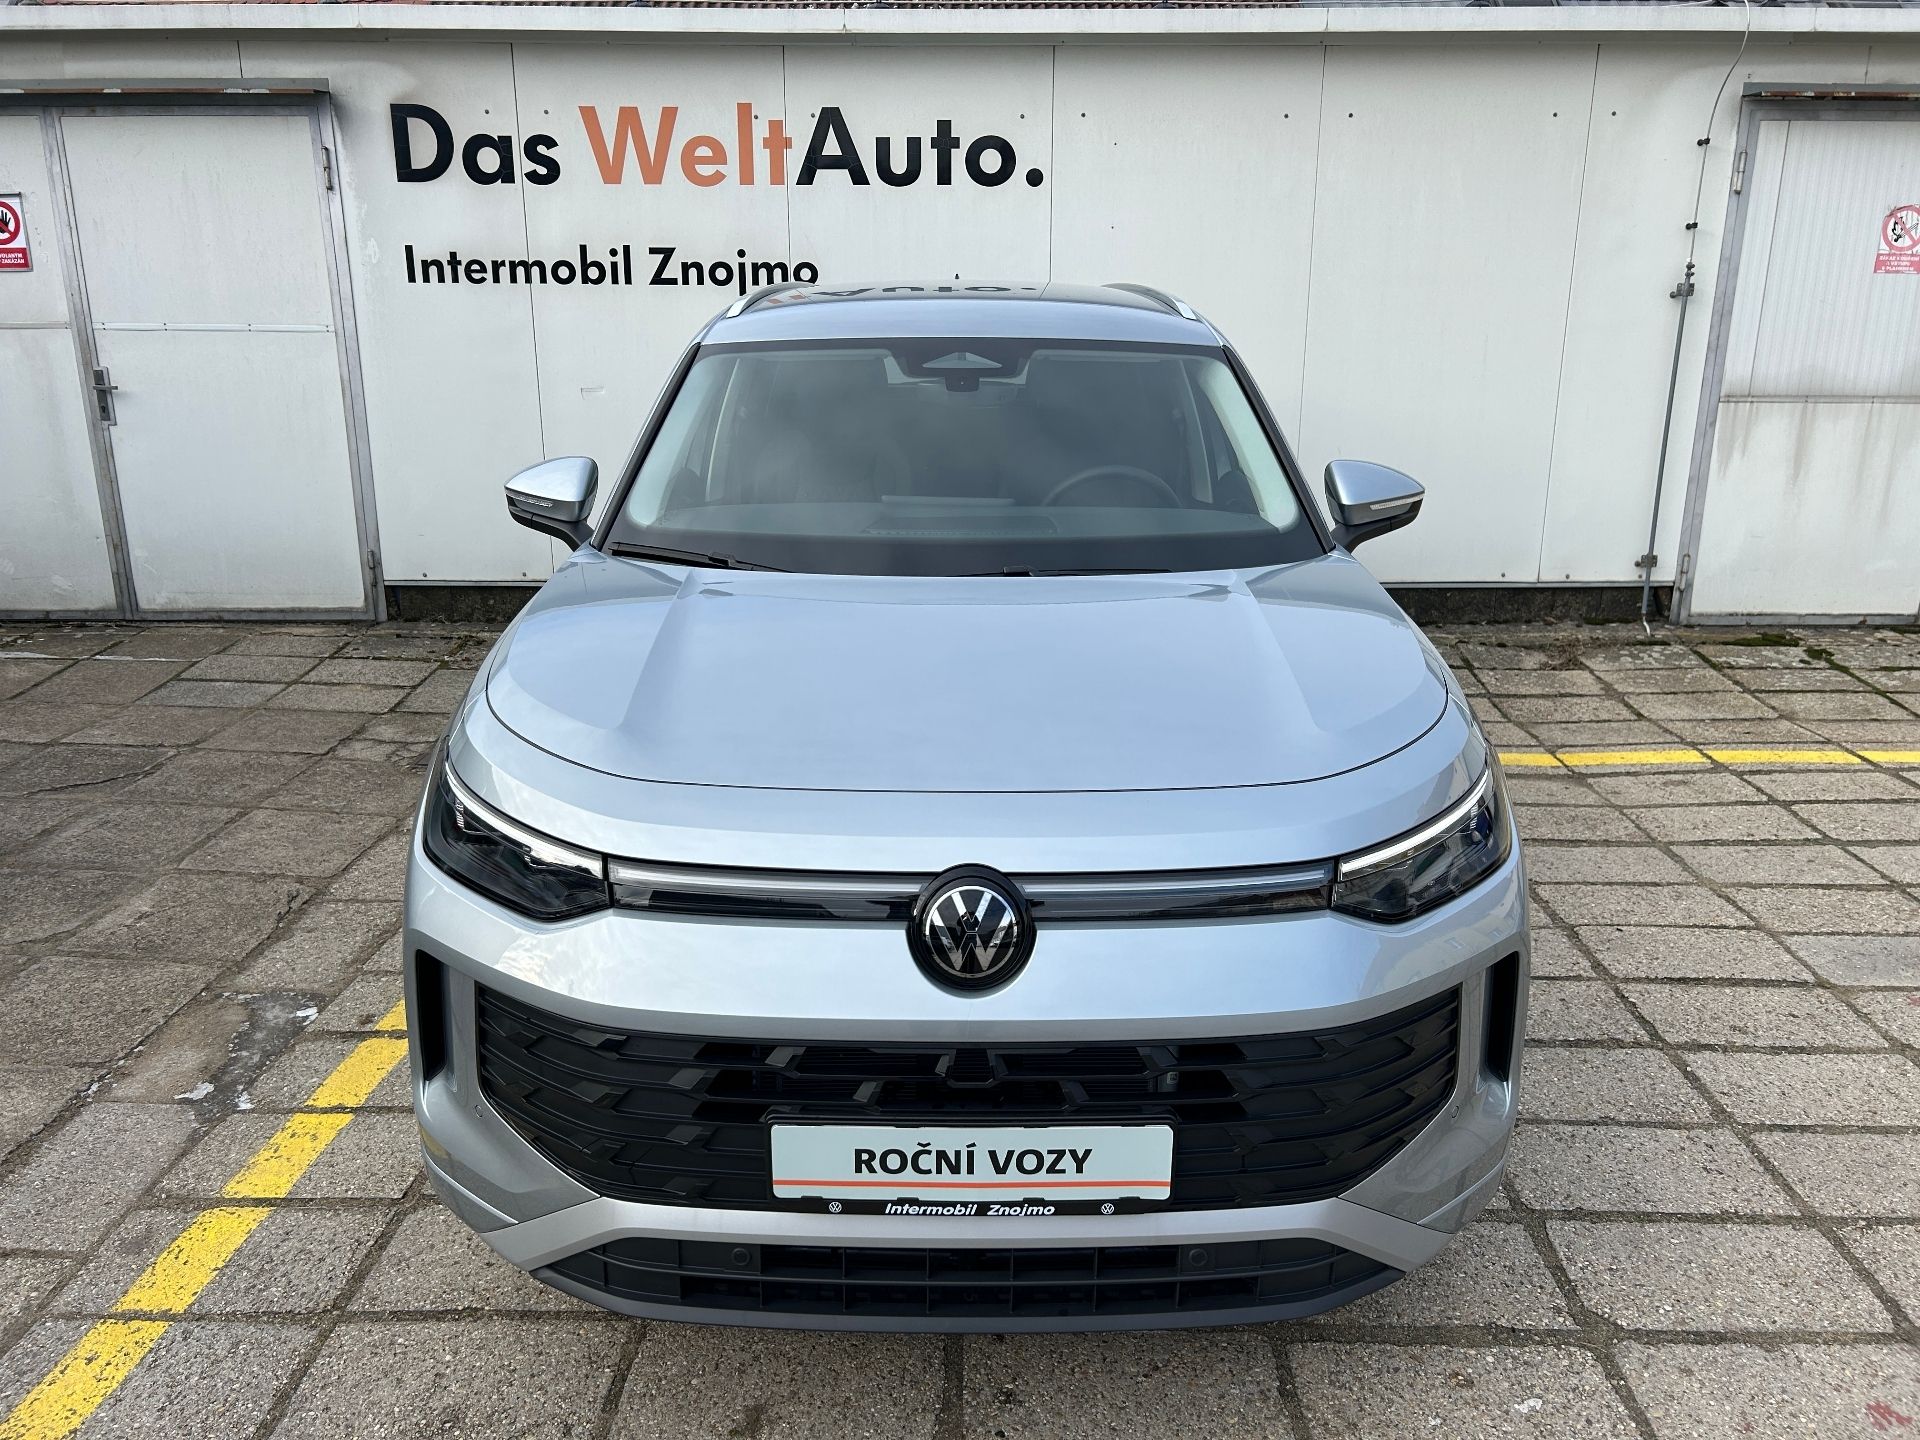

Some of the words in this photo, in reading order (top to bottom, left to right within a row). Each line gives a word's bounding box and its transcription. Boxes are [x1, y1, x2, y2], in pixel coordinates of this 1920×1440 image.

[389, 103, 561, 186] Das
[578, 102, 1044, 188] WeltAuto.
[404, 244, 633, 286] Intermobil
[648, 247, 819, 297] Znojmo
[854, 1141, 976, 1175] ROČNÍ
[988, 1148, 1093, 1175] VOZY
[885, 1202, 977, 1216] Intermobil
[987, 1204, 1056, 1217] Znojmo
